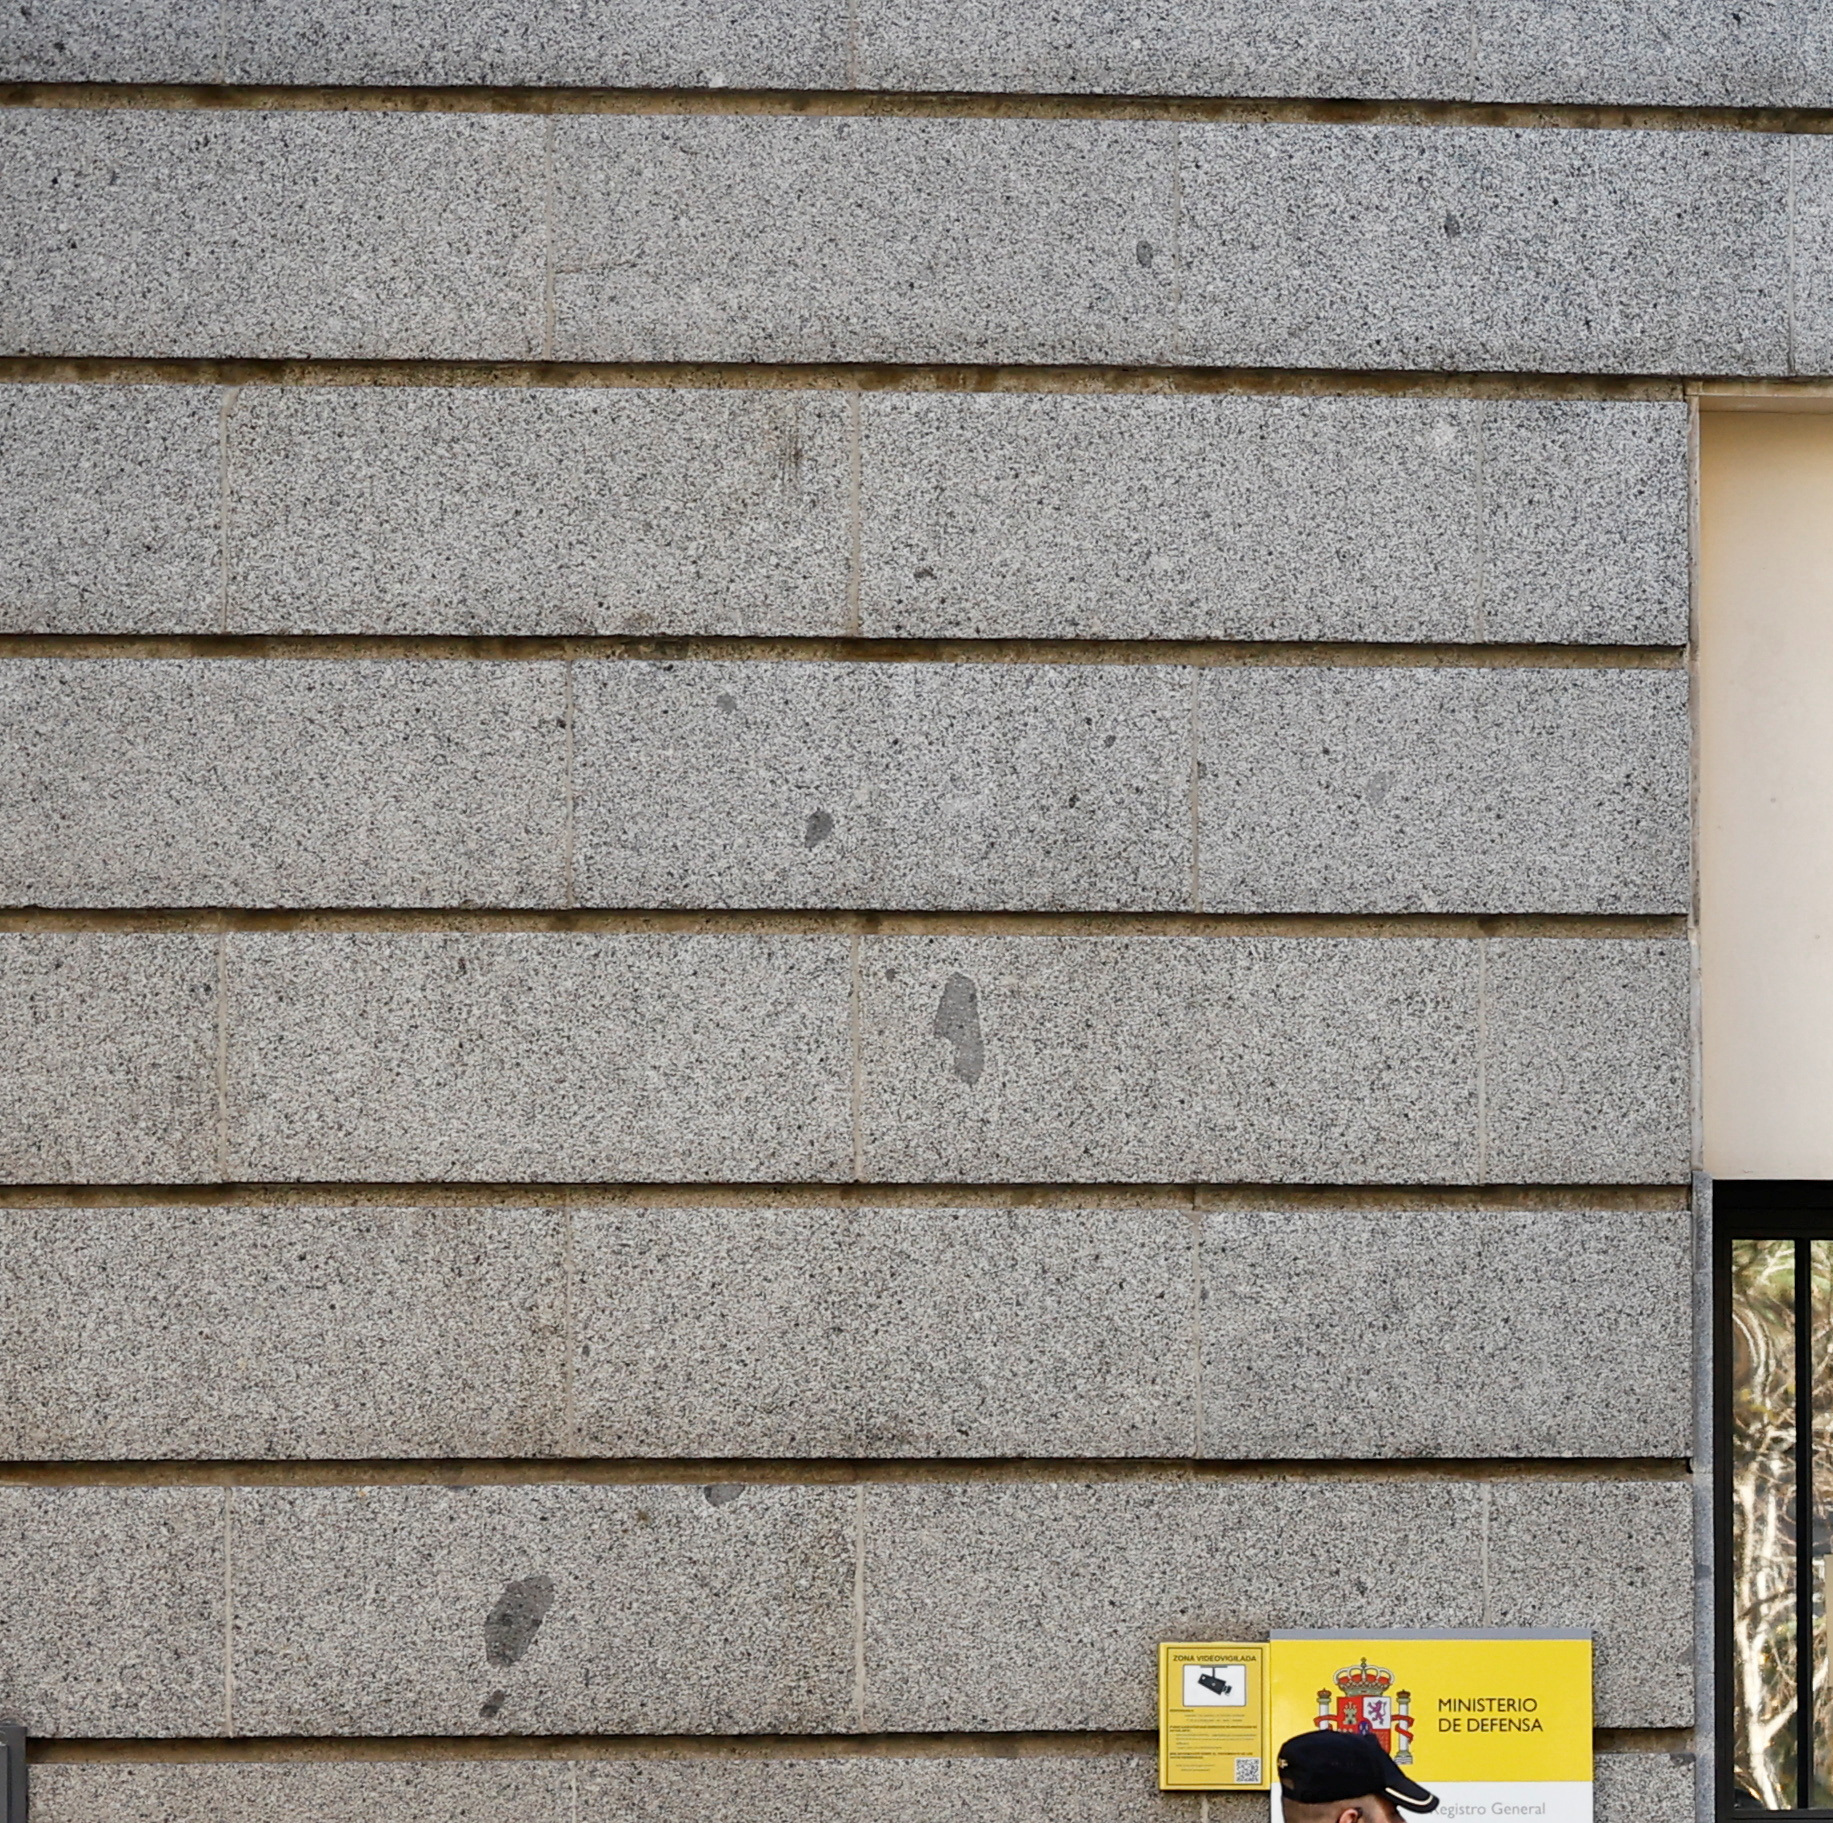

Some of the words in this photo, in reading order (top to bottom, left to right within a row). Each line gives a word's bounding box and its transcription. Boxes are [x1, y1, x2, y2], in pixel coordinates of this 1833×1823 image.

[1438, 1698, 1538, 1713] MINISTERIO
[1438, 1718, 1462, 1733] DE
[1467, 1718, 1544, 1733] DEFENSA
[1491, 1802, 1546, 1815] General
